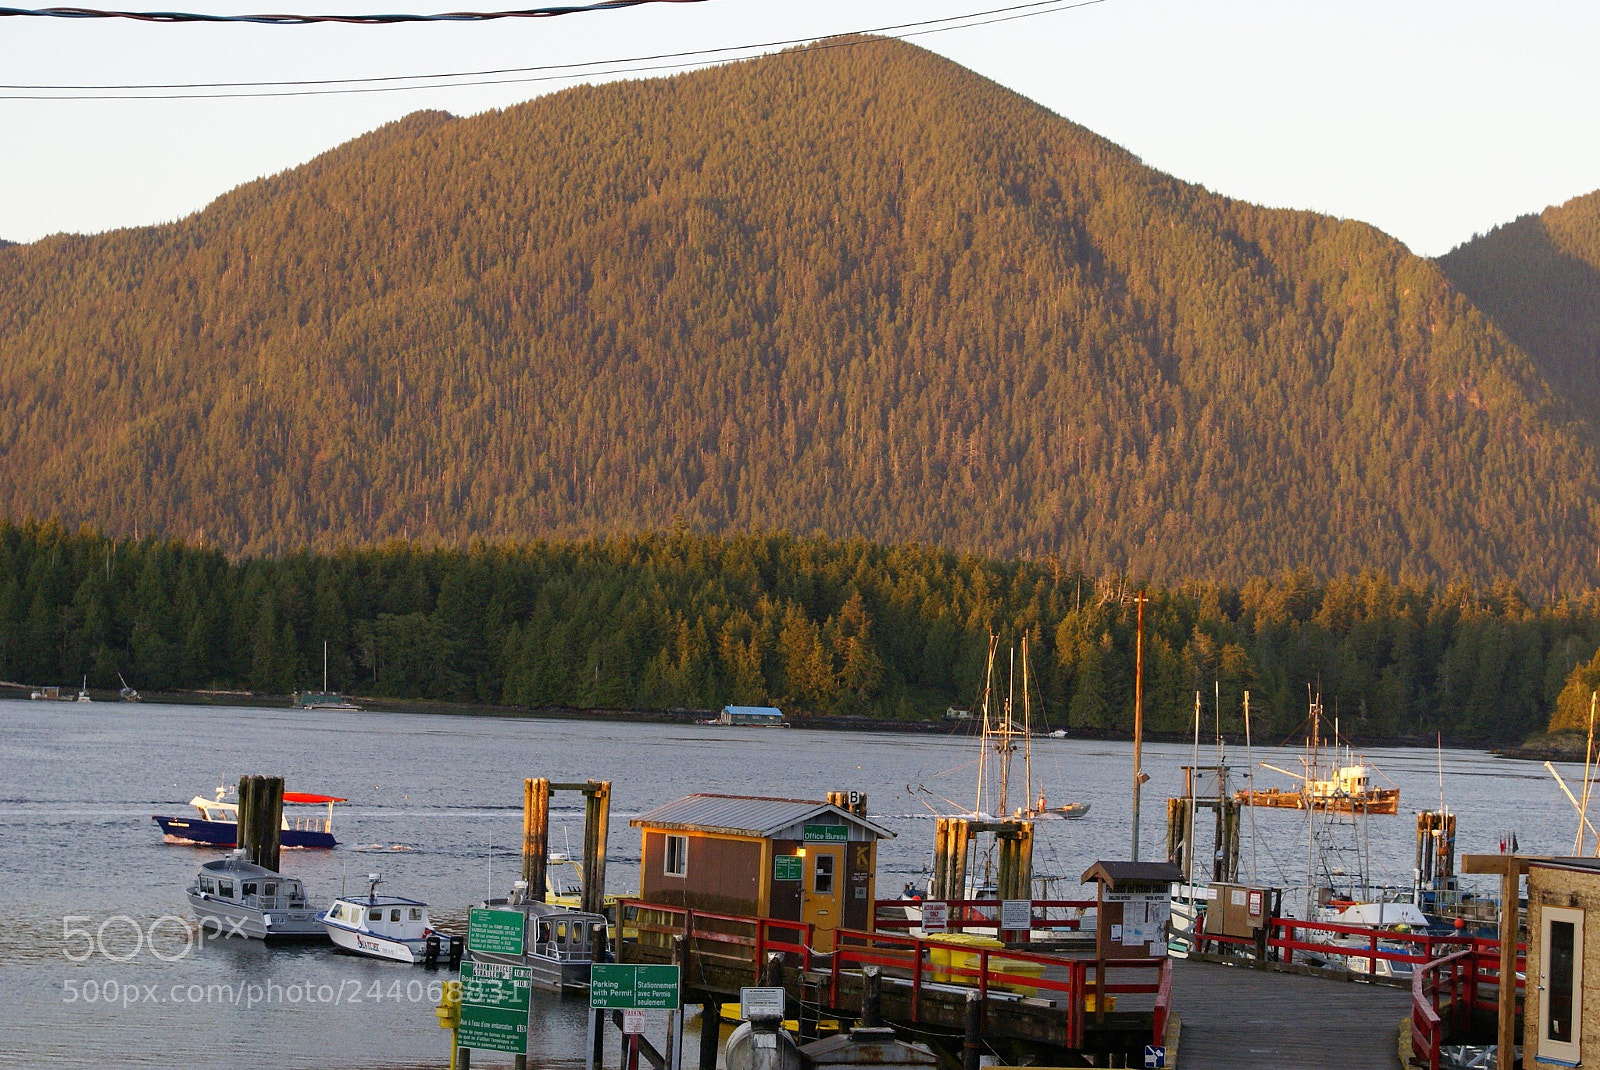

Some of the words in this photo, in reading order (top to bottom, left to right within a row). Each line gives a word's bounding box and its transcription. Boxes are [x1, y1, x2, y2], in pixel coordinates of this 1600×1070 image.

[850, 791, 858, 803] B
[804, 832, 824, 840] Office
[826, 832, 846, 840] Bureau
[488, 964, 512, 972] VEHICLE
[593, 980, 618, 989] Parking
[637, 981, 678, 989] Stationnement
[592, 998, 607, 1006] only
